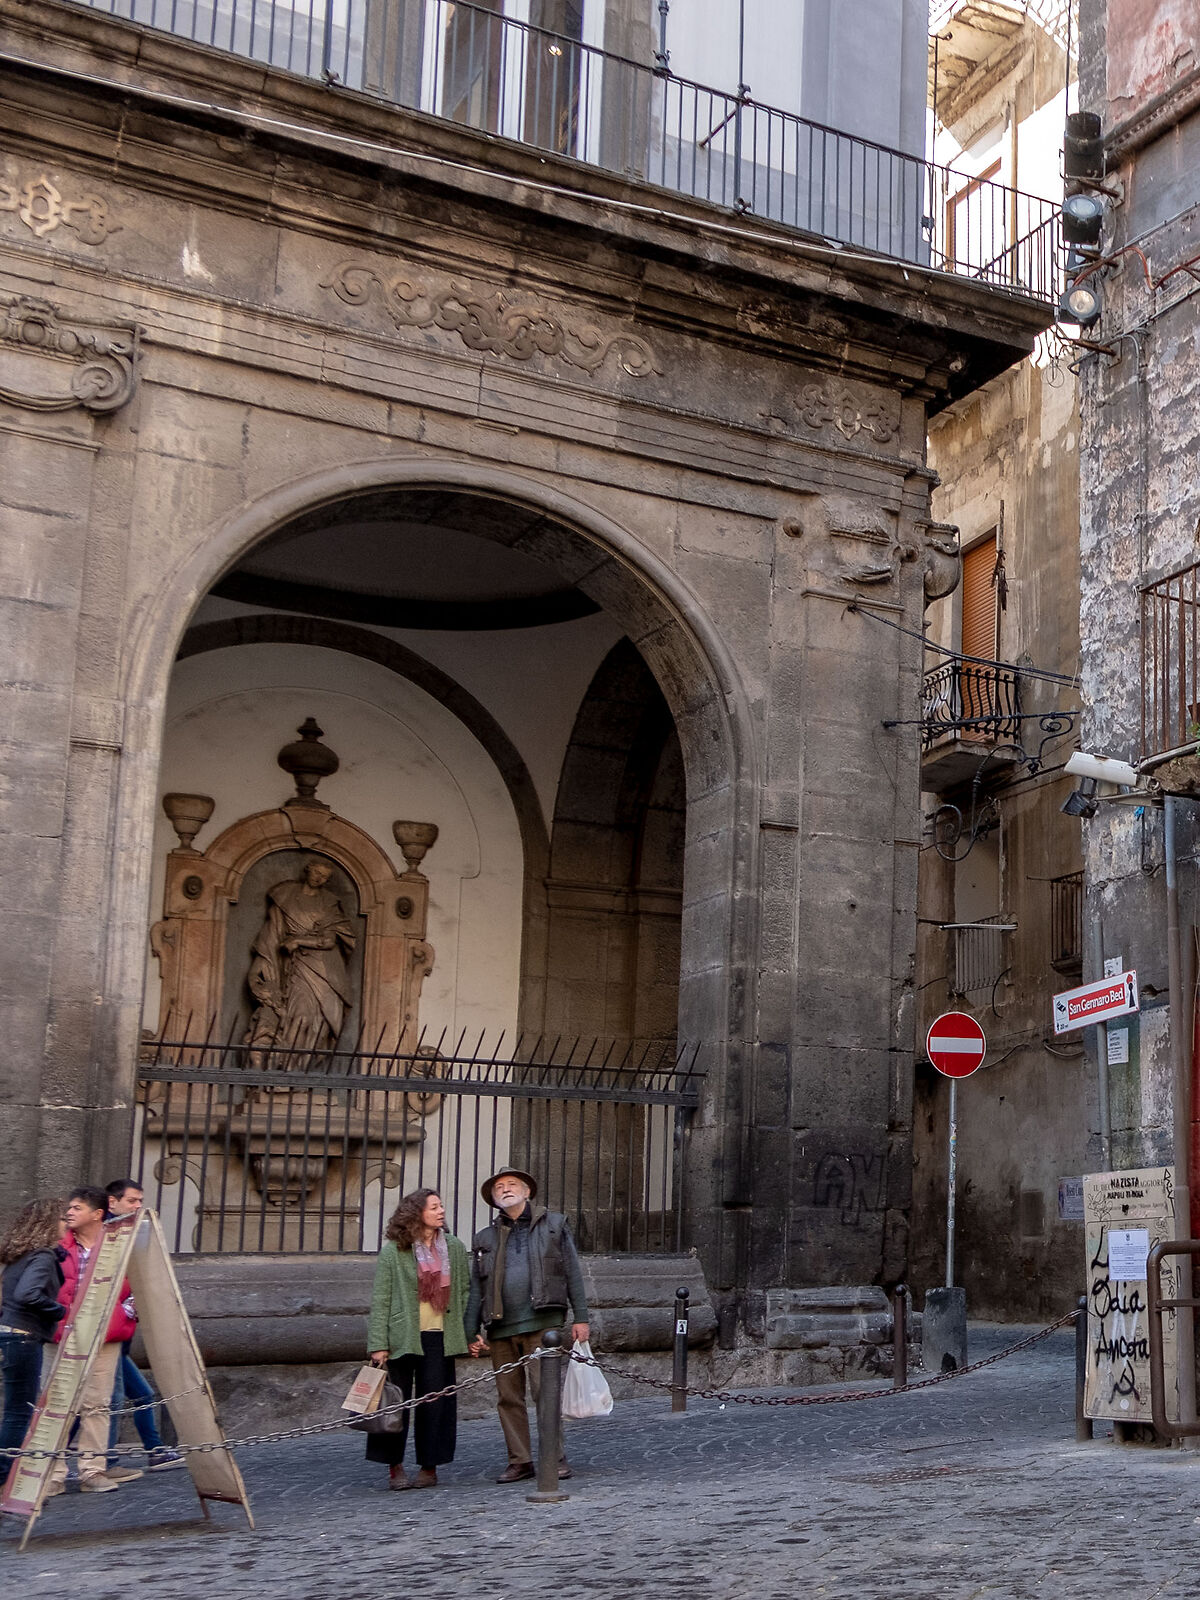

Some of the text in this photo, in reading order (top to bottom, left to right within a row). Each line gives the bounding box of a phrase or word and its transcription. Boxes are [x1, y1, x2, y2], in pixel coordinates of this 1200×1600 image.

[1069, 987, 1124, 1015] San Gennaro Bed
[1110, 1177, 1140, 1189] NAZISTA
[1095, 1321, 1150, 1367] Ancora
